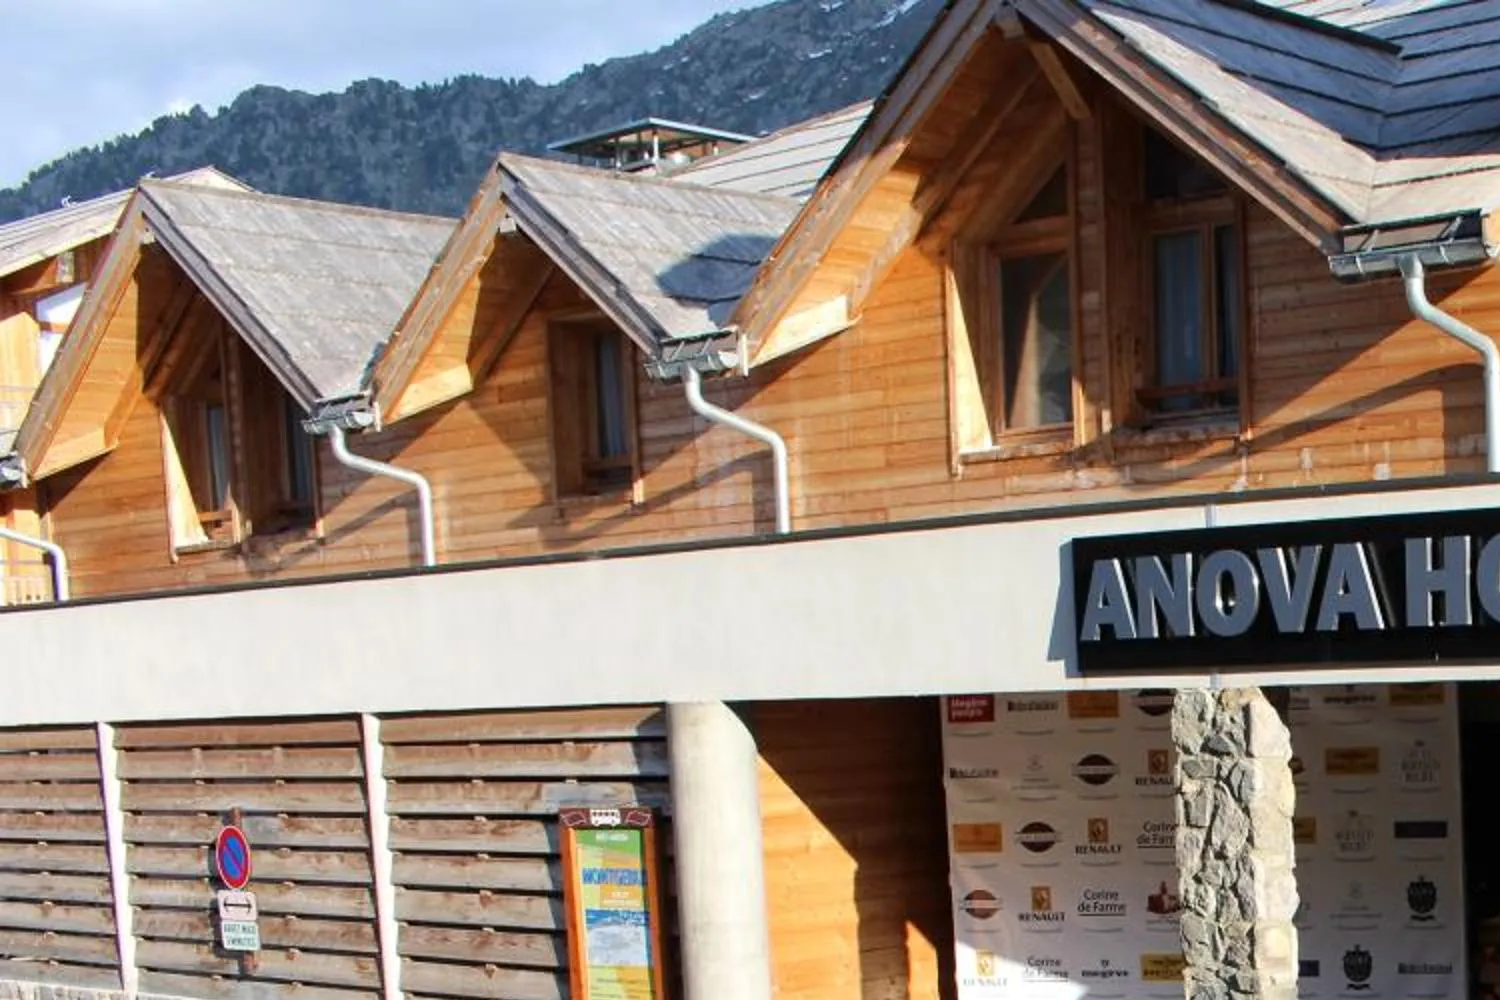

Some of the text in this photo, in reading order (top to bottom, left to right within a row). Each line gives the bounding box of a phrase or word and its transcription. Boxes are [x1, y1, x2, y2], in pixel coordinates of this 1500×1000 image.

[1079, 539, 1387, 643] ANOVA
[1083, 888, 1120, 901] Corine
[1077, 901, 1091, 913] de
